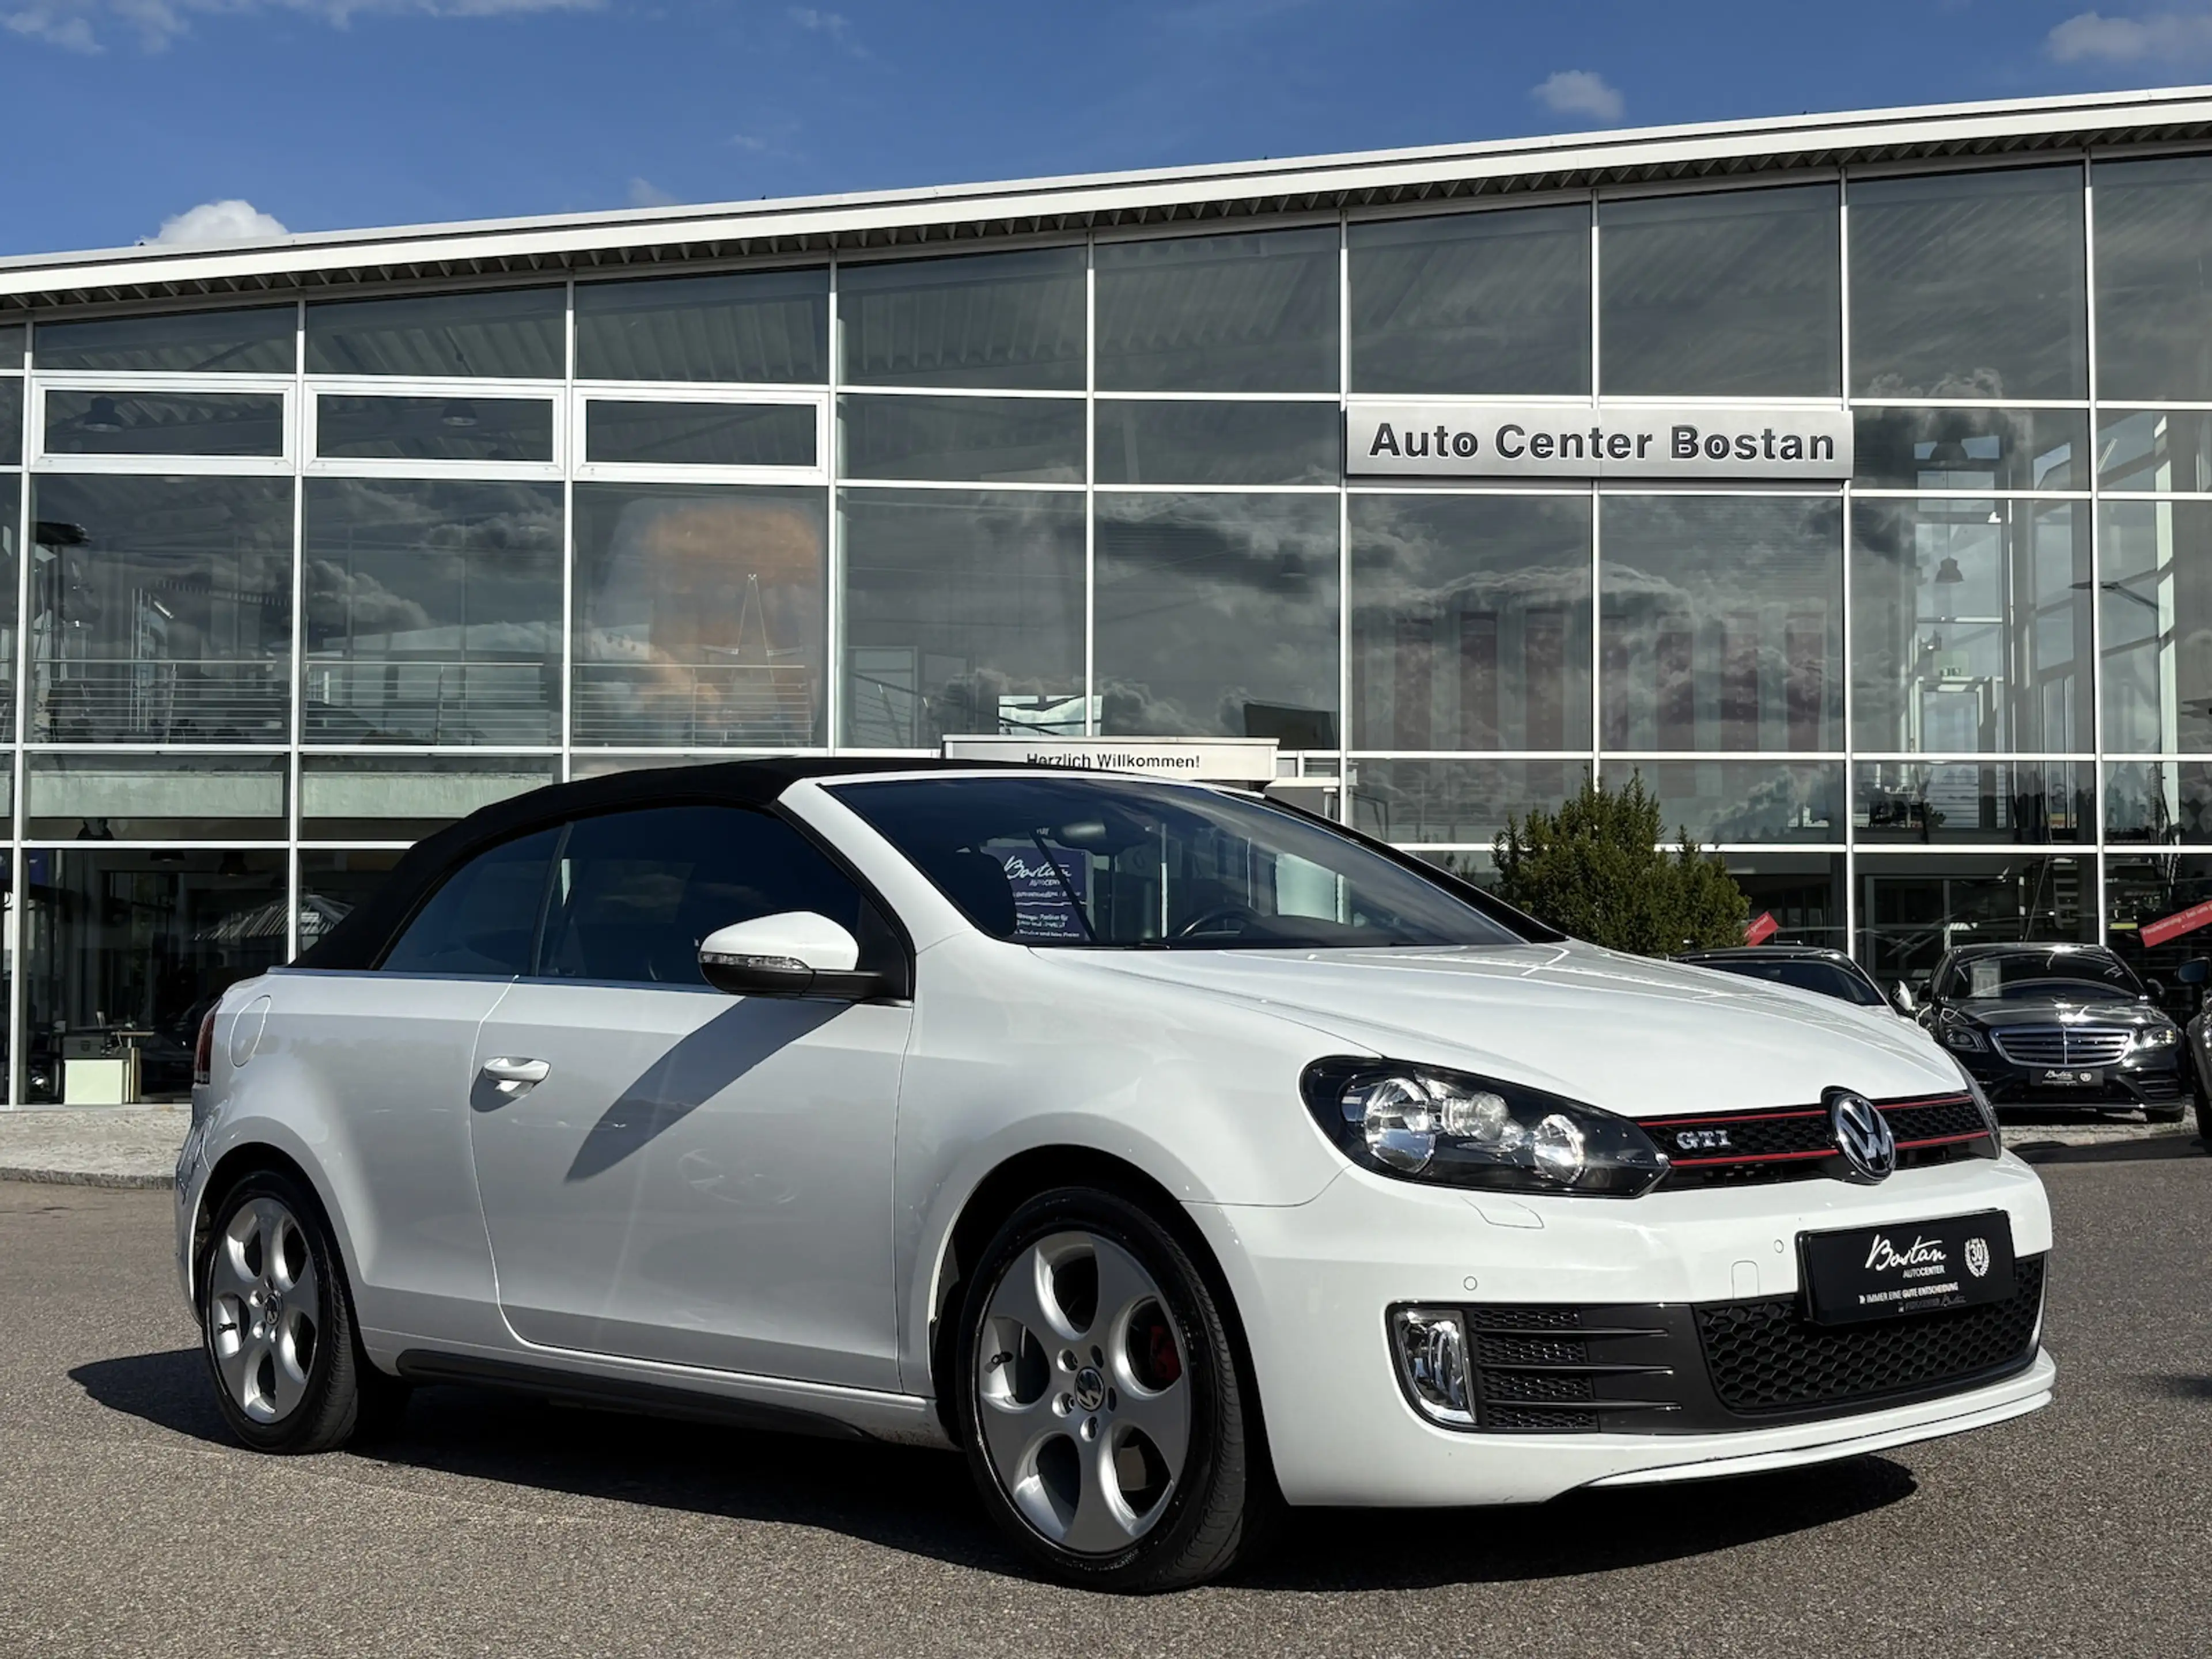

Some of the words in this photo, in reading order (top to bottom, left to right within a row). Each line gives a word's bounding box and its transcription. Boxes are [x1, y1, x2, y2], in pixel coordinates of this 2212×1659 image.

[1368, 422, 1479, 459] Auto
[1495, 424, 1652, 461] Center
[1670, 426, 1835, 461] Bostan
[1027, 753, 1091, 768] Herzlich
[1097, 753, 1200, 769] Willkommen!
[1676, 1130, 1731, 1150] GTI
[1865, 1234, 1946, 1271] Bostan
[1903, 1264, 1946, 1278] AUTOCENTER
[1866, 1291, 1888, 1304] IMMER
[1902, 1287, 1918, 1298] GUTE
